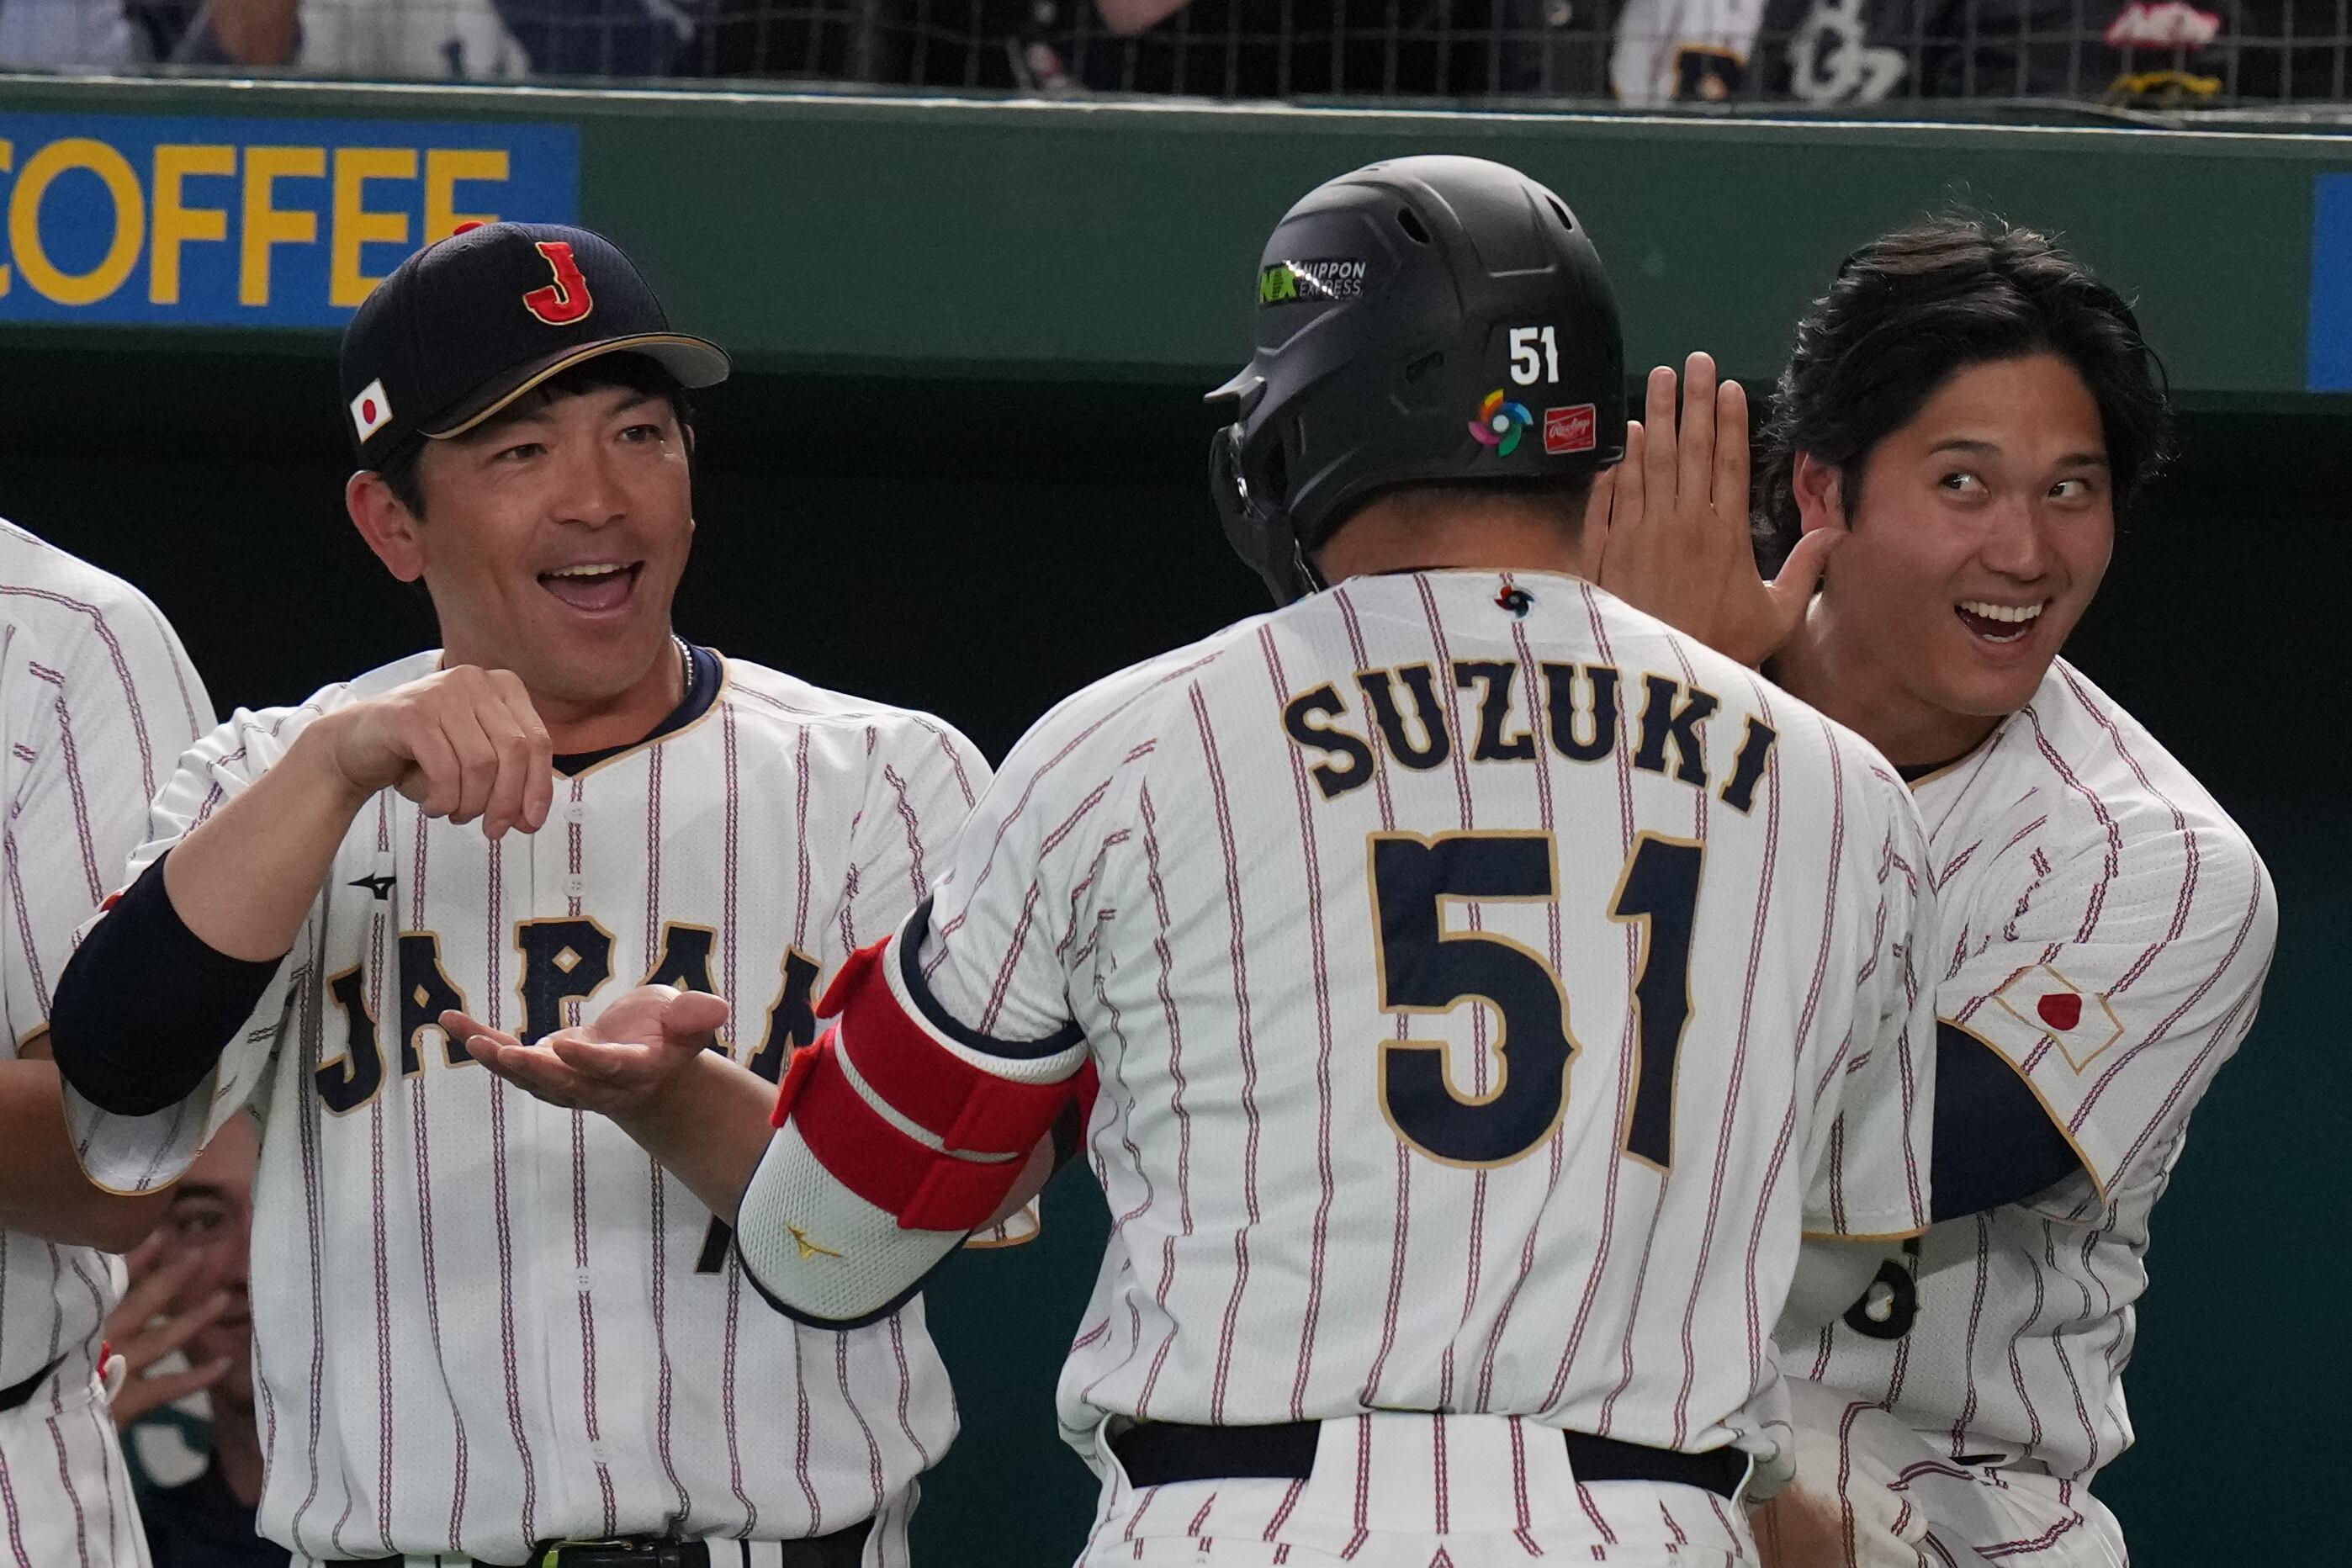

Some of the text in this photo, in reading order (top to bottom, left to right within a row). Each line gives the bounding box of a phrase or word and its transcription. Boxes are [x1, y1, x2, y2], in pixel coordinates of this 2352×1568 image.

[0, 137, 510, 308] OFFEE
[1302, 261, 1366, 279] NIPPON
[522, 241, 594, 326] J
[1509, 326, 1560, 385] 51
[1280, 659, 1781, 817] SUZUKI
[1366, 829, 1707, 1175] 51
